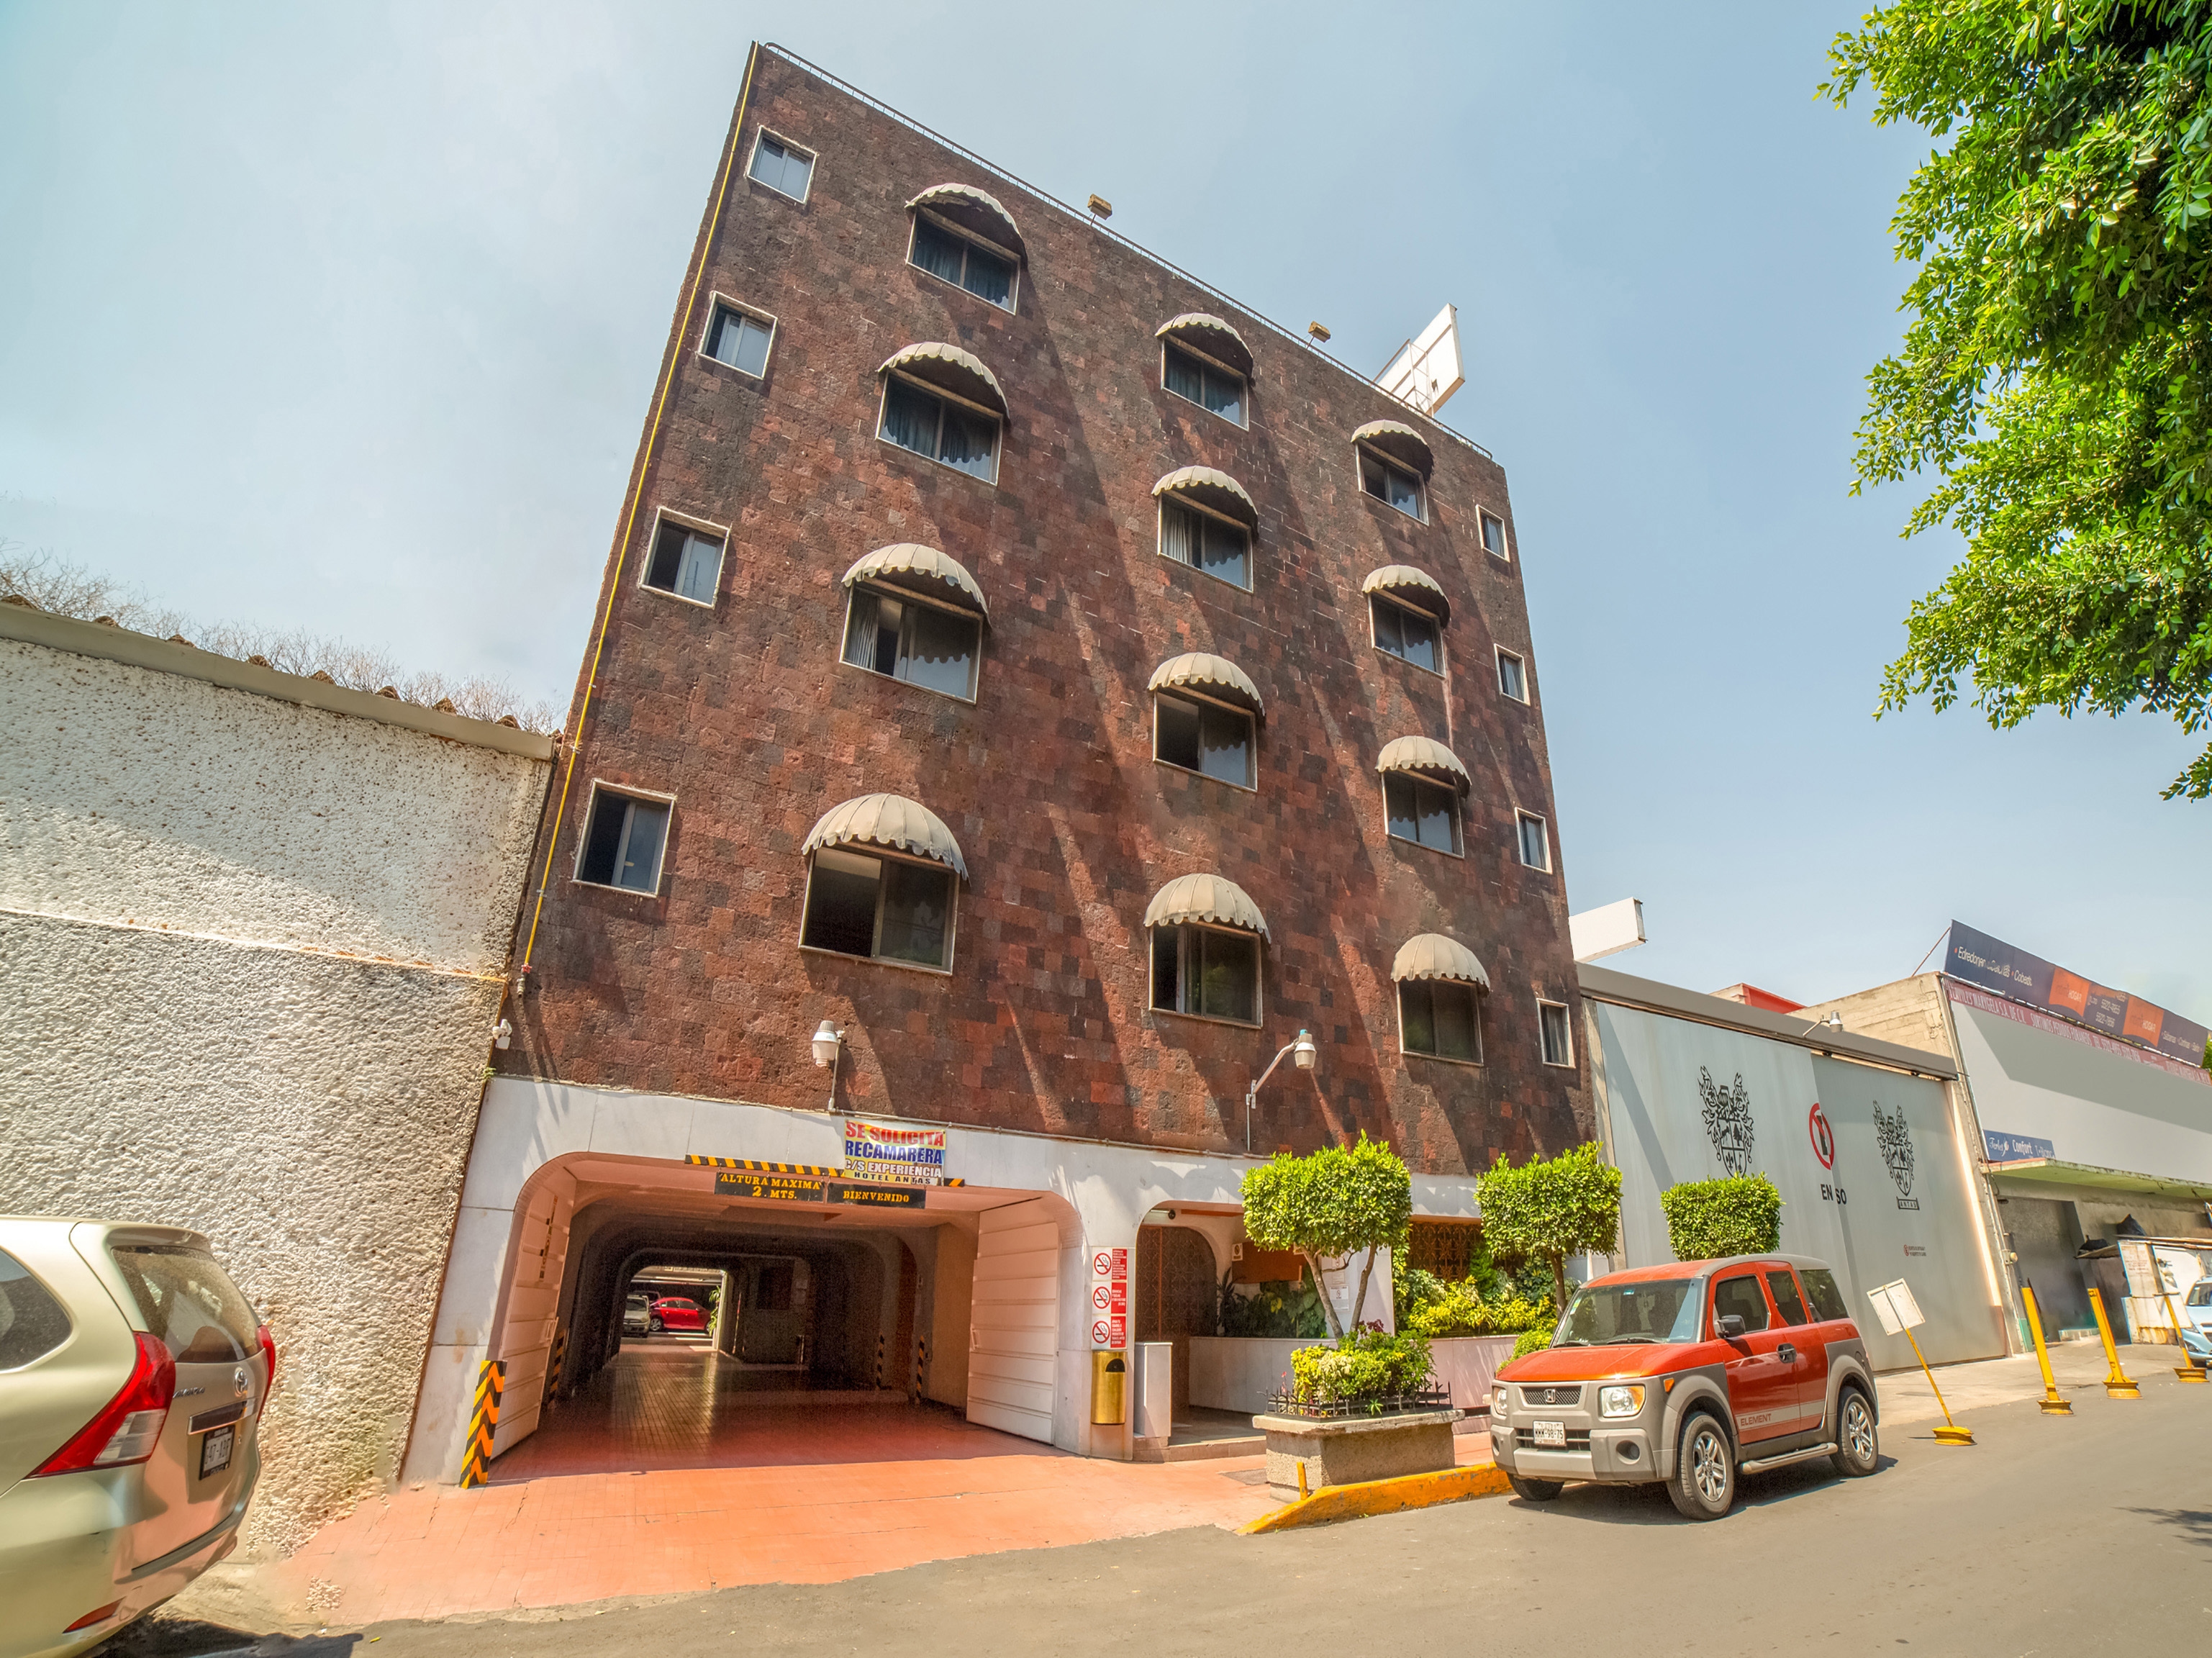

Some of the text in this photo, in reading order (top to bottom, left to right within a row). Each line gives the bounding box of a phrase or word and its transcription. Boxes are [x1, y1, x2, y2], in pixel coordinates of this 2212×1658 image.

[846, 1121, 944, 1146] SE SOLICITA
[845, 1140, 943, 1164] RECAMARERA
[2012, 1139, 2033, 1156] Confort
[845, 1158, 942, 1178] C/S EXPERIENCIA
[720, 1173, 821, 1190] ALTURA MAXIMA
[854, 1172, 930, 1184] HOTEL ANTAS
[843, 1190, 910, 1203] BIENVENIDO
[1821, 1183, 1833, 1201] EN
[1740, 1413, 1772, 1426] ELEMENT
